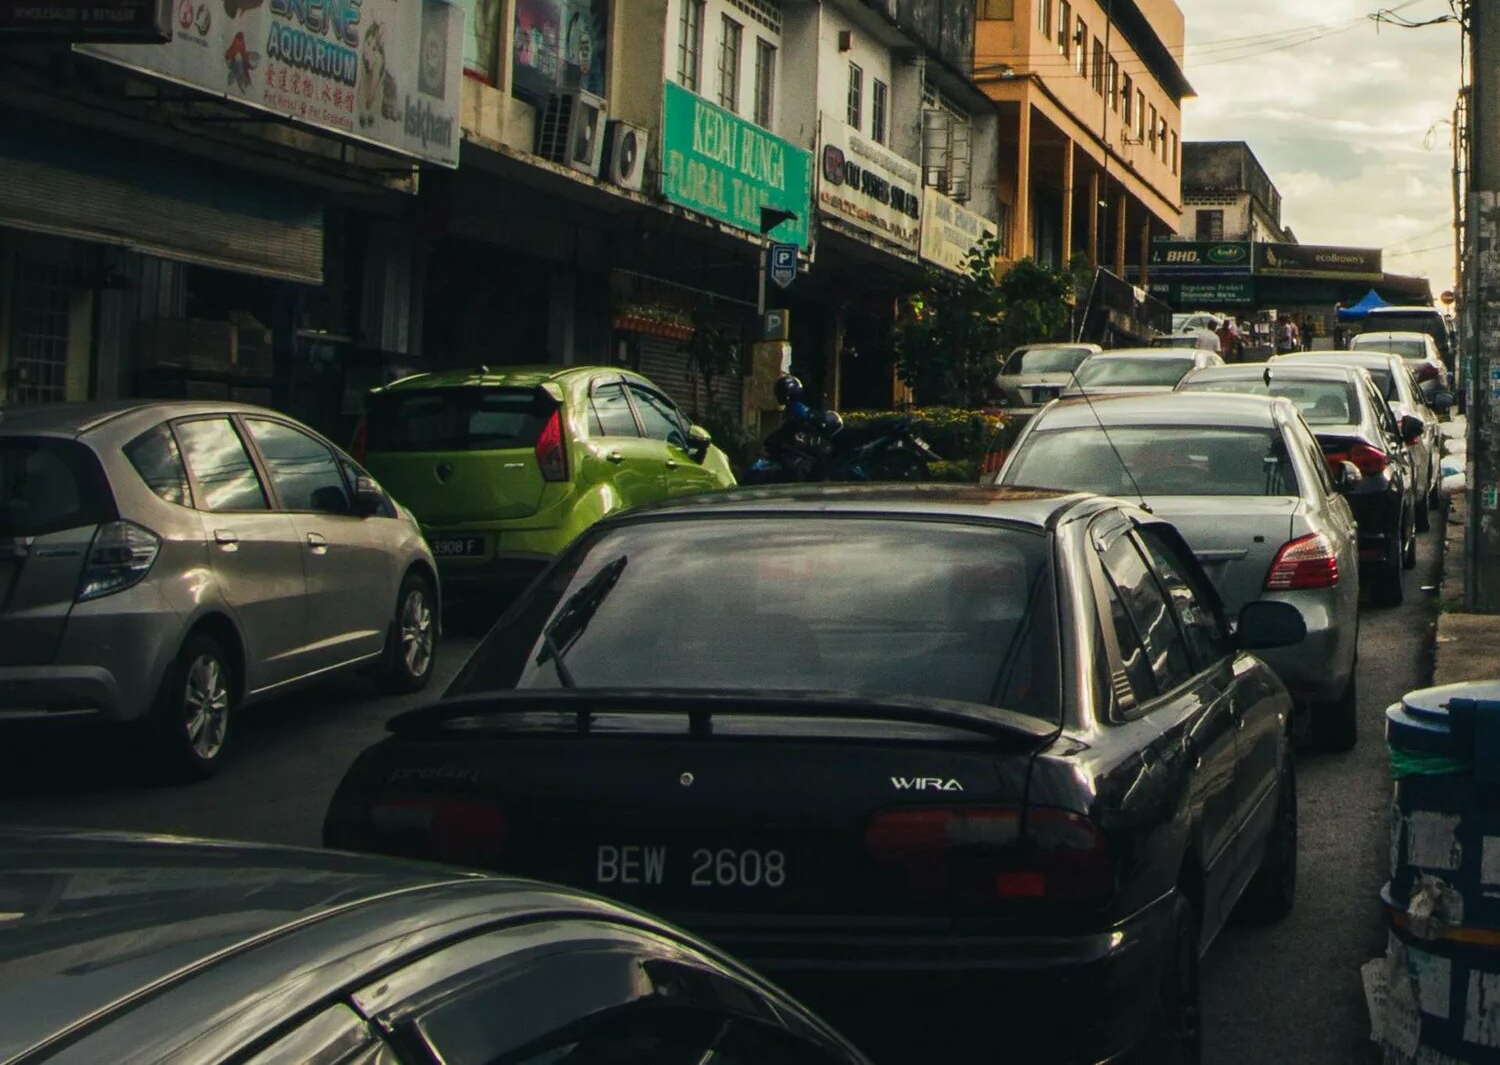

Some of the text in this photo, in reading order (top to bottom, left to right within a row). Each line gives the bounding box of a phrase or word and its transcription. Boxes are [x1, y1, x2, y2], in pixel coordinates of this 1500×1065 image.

[266, 21, 358, 88] AQUARIUM
[692, 101, 738, 169] KEDAI
[740, 126, 785, 192] BUNGA
[668, 148, 728, 214] FLORAL
[779, 253, 790, 264] P
[1166, 250, 1200, 263] BHD.
[1315, 253, 1365, 264] ecoBrown's
[768, 315, 781, 332] P
[891, 776, 964, 792] WIRA
[596, 845, 787, 887] BEW 2608
